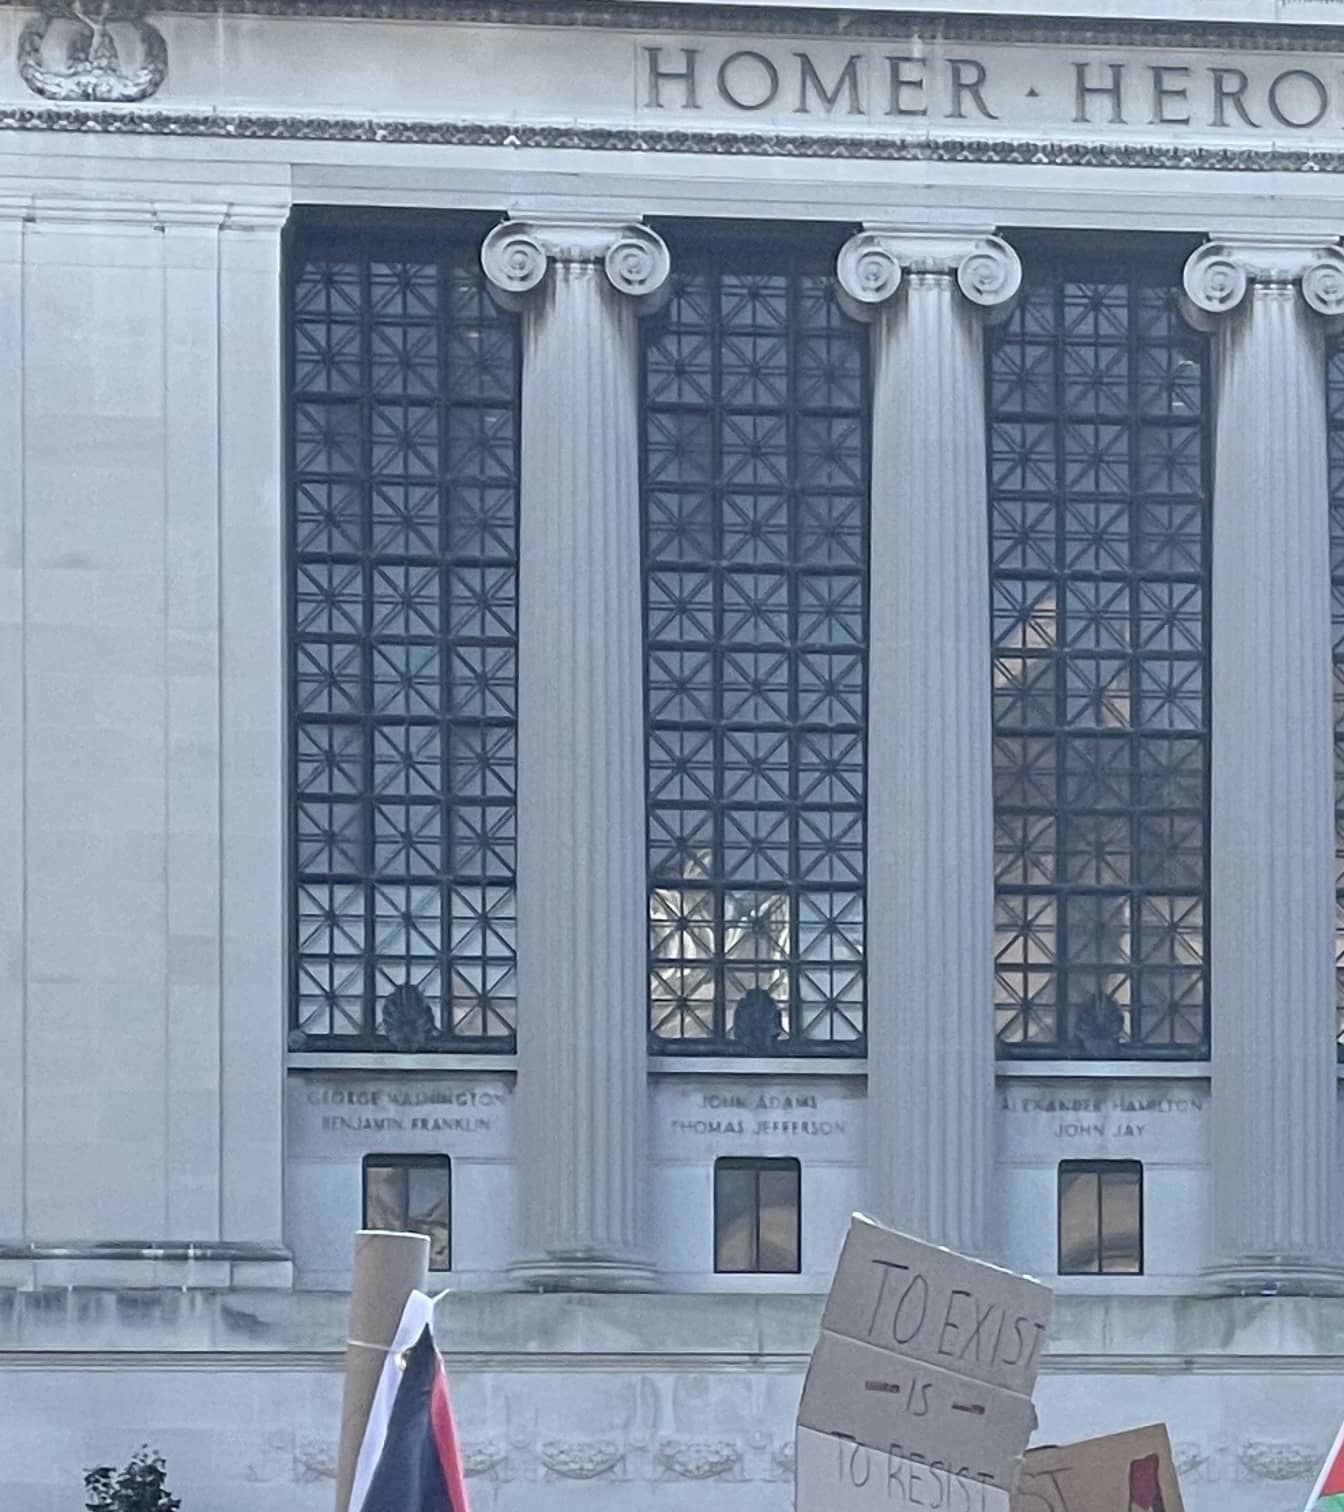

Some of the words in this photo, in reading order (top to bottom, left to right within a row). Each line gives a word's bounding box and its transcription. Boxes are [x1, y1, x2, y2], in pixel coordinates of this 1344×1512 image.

[642, 44, 1003, 122] HOMER
[411, 1117, 491, 1132] FRANKLIN
[671, 1120, 744, 1135] THOMAS
[754, 1120, 846, 1136] JEFFERSON
[1054, 1123, 1106, 1138] JOHN
[1112, 1123, 1148, 1138] JAY
[866, 1258, 928, 1344] TO
[937, 1290, 1047, 1370] EXIST
[904, 1379, 933, 1417] IS
[831, 1431, 870, 1488] TO
